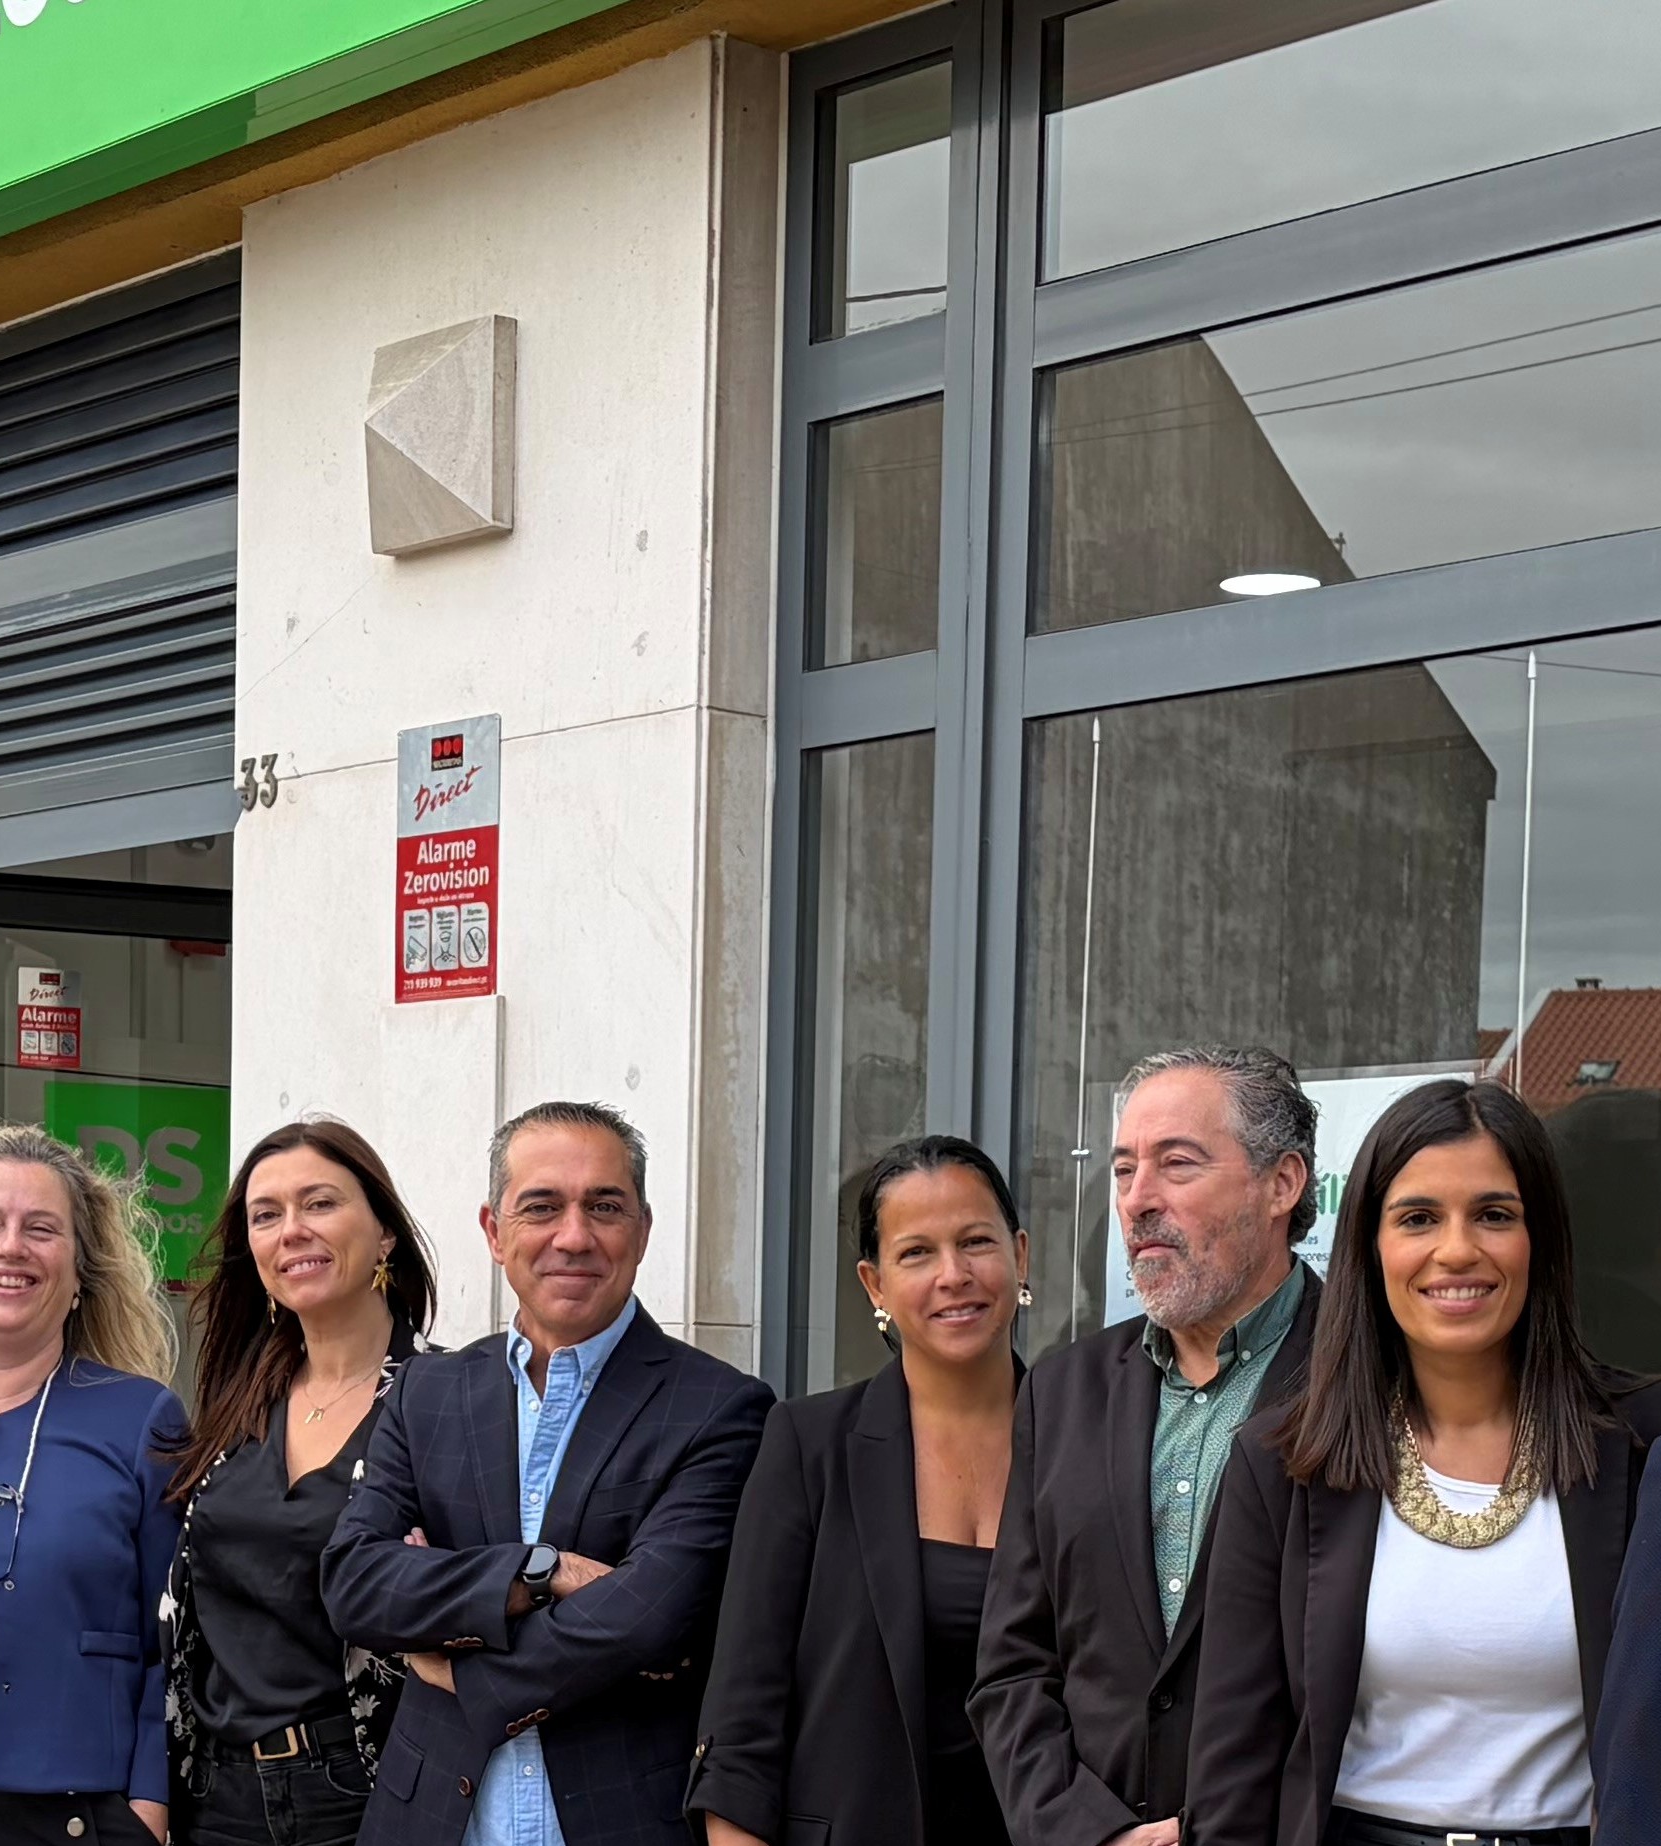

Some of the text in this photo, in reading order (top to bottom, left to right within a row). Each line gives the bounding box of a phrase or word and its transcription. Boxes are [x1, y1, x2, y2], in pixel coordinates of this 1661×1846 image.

[241, 753, 279, 811] 33
[413, 765, 483, 822] Direct
[417, 838, 477, 865] Alarme
[403, 860, 490, 895] Zerovision
[22, 1007, 77, 1023] Alarme
